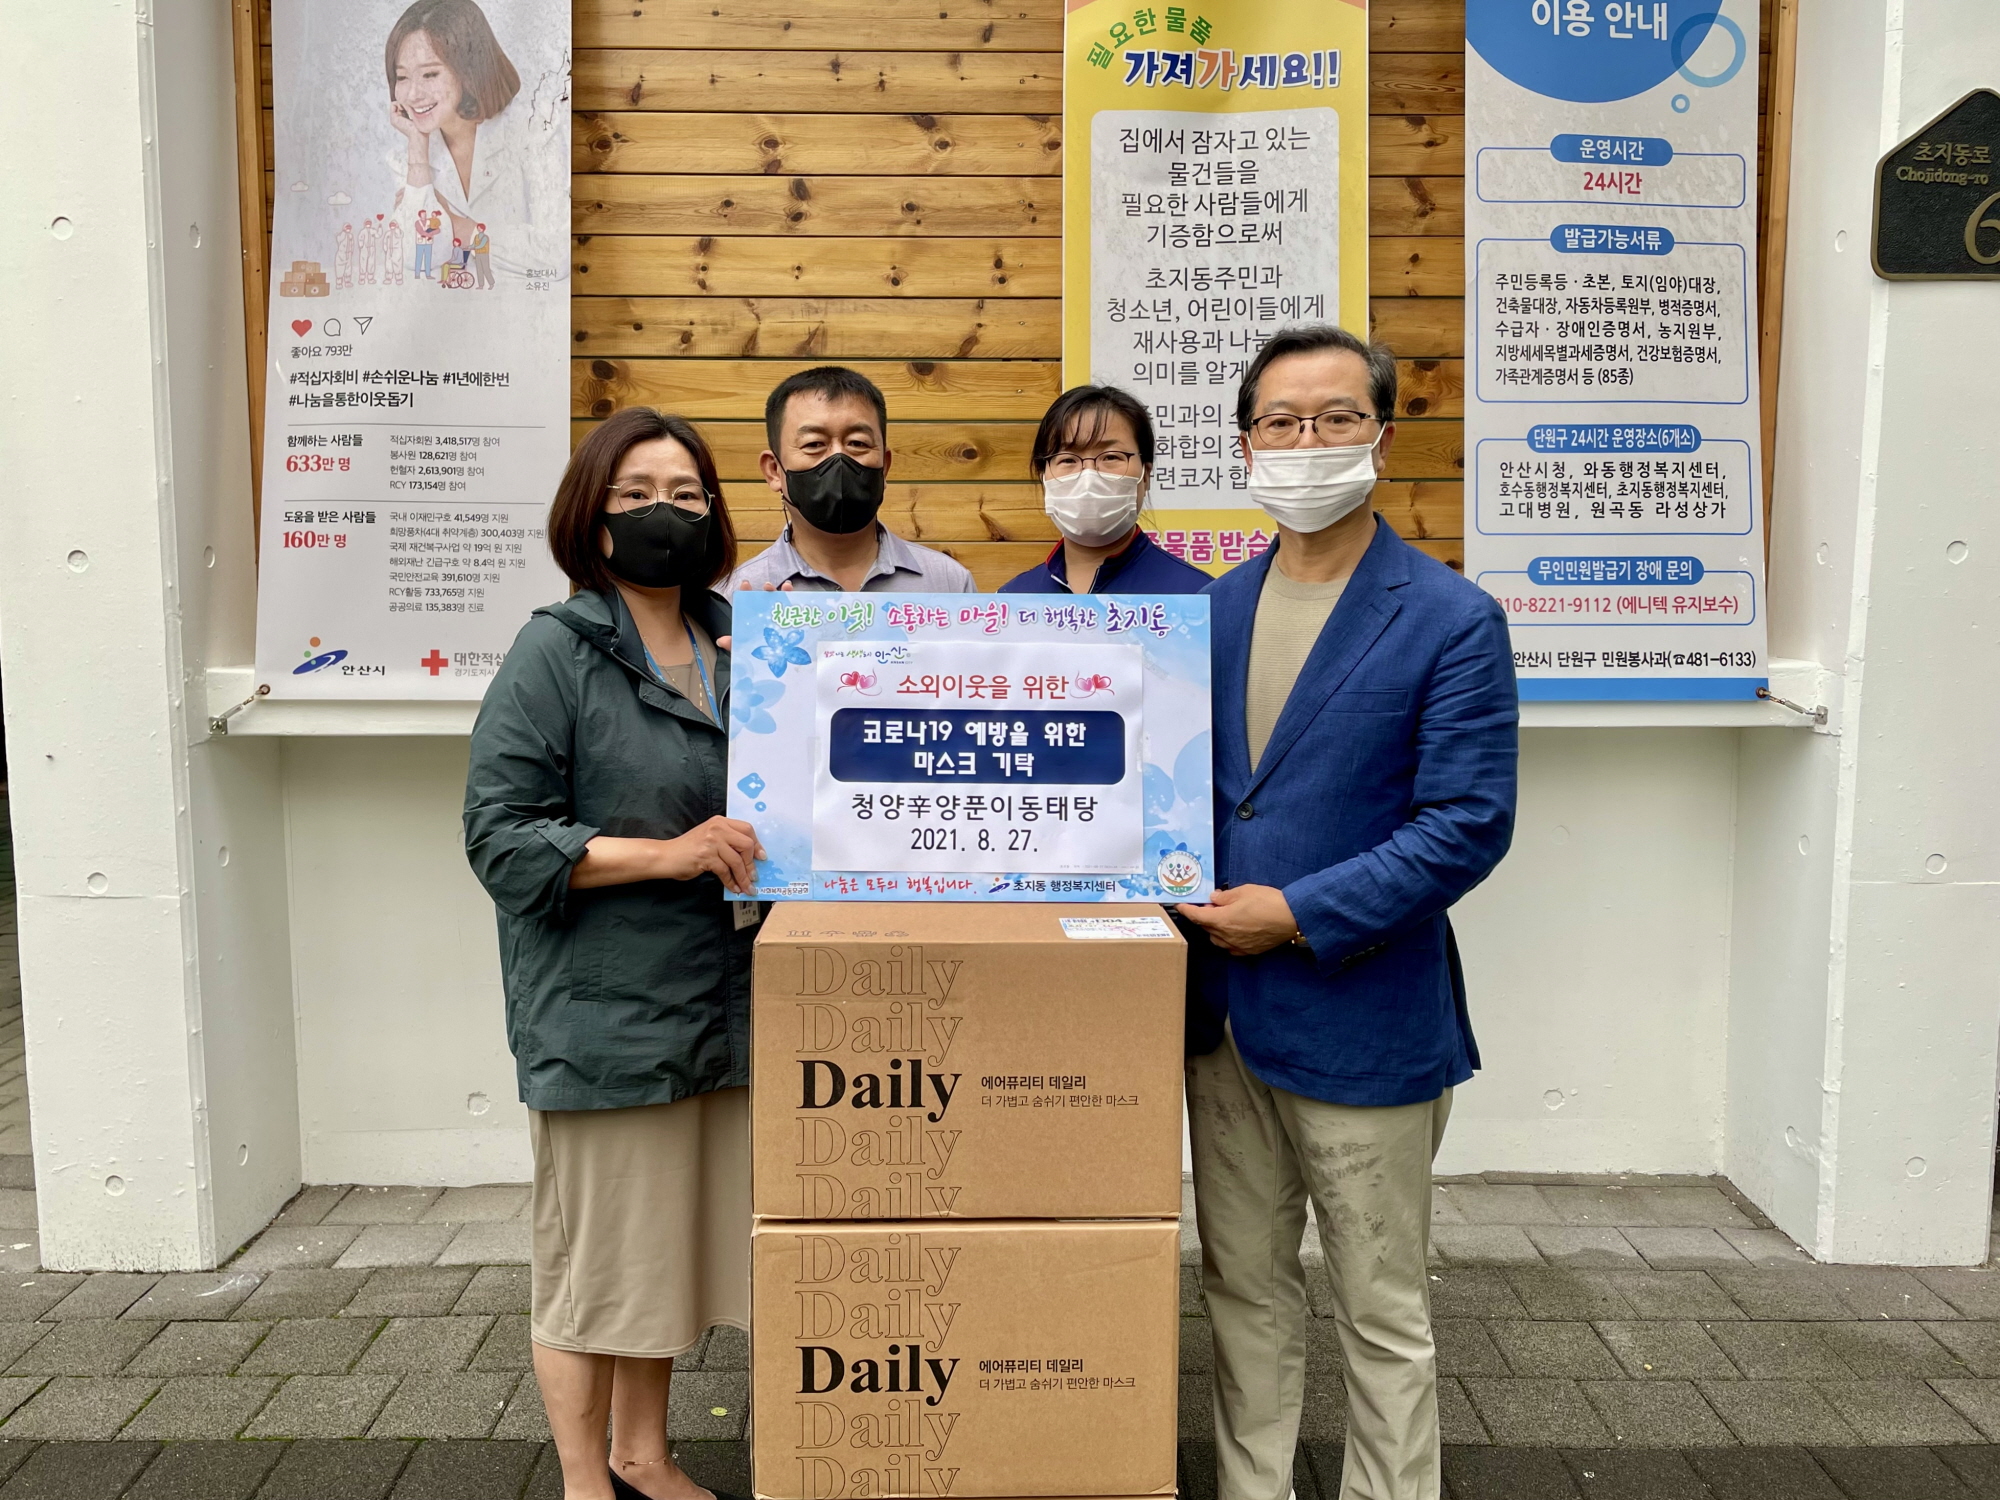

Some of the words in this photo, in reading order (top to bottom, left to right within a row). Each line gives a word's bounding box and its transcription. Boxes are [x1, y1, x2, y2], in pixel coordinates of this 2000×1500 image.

[1532, 0, 1594, 37] 이용
[1605, 1, 1667, 40] 안내
[1124, 49, 1340, 91] 가져가세요!!
[1119, 128, 1184, 154] 집에서
[1191, 129, 1259, 154] 잠자고
[1266, 127, 1310, 151] 있는
[1579, 139, 1644, 161] 운영시간
[1913, 142, 1991, 165] 초지동로
[1168, 160, 1259, 186] 물건들을
[1896, 167, 1989, 185] Chojidong-ro
[1583, 172, 1642, 195] 24시간
[1122, 192, 1188, 217] 필요한
[1194, 188, 1307, 216] 사람들에게
[1147, 221, 1282, 248] 기증함으로써
[1565, 228, 1661, 250] 발급가능서류
[526, 269, 557, 278] 홍보대사
[1146, 265, 1282, 291] 초지동주민과
[526, 281, 549, 291] 소유진
[1495, 274, 1568, 291] 주민등록등
[1582, 274, 1615, 292] 초본,
[1621, 275, 1721, 295] 토지(임야)대장,
[1107, 298, 1181, 323] 청소년,
[1188, 294, 1325, 320] 어린이들에게
[1496, 297, 1561, 315] 건축물대장,
[1565, 297, 1654, 316] 자동차등록원부,
[1659, 298, 1720, 318] 병적증명서,
[1495, 321, 1539, 338] 수급자
[1556, 321, 1651, 340] 장애인증명서,
[1658, 323, 1721, 341] 농지원부,
[1133, 329, 1223, 353] 재사용과
[291, 346, 322, 358] 좋아요
[325, 345, 352, 357] 793만
[1495, 345, 1633, 363] 지방세세목별과세증명서,
[1637, 345, 1721, 364] 건강보험증명서,
[290, 370, 358, 386] #적십자회비
[363, 370, 439, 385] #손쉬운나눔
[443, 371, 509, 387] #1년에한번
[1133, 361, 1200, 385] 의미를
[1495, 368, 1578, 385] 가족관계증명서
[1582, 368, 1594, 385] 등
[1598, 368, 1633, 385] (85종)
[289, 393, 413, 407] #나눔을통한이웃돕기
[287, 435, 327, 447] 함께하는
[331, 434, 363, 447] 사람들
[390, 434, 432, 446] 적십자회원
[435, 437, 480, 447] 3,418,517명
[483, 436, 500, 447] 참여
[1534, 429, 1567, 448] 단원구
[1572, 429, 1609, 448] 24시간
[1612, 429, 1695, 449] 운영장소(6개소)
[286, 455, 334, 472] 633만
[338, 456, 350, 472] 명
[390, 450, 416, 460] 봉사원
[419, 451, 457, 461] 128,621명
[460, 451, 477, 461] 참여
[390, 465, 415, 476] 헌혈자
[418, 466, 464, 476] 2,613,901명
[467, 466, 484, 477] 참여
[1500, 461, 1573, 479] 안산시청,
[1584, 461, 1726, 479] 와동행정복지센터,
[390, 480, 405, 490] RCY
[409, 481, 446, 491] 173,154명
[449, 481, 466, 491] 참여
[1499, 481, 1612, 499] 호수동행정복지센터,
[1617, 481, 1729, 499] 초지동행정복지센터,
[284, 511, 314, 523] 도움을
[318, 511, 338, 523] 받은
[342, 511, 376, 524] 사람들
[390, 512, 407, 522] 국내
[410, 512, 451, 522] 이재민구호
[454, 513, 489, 523] 41,549명
[492, 514, 509, 523] 지원
[1499, 502, 1579, 520] 고대병원,
[1591, 501, 1644, 519] 원곡동
[1655, 501, 1726, 519] 라성상가
[283, 530, 330, 548] 160만
[334, 533, 346, 548] 명
[389, 572, 439, 582] 국민안전교육
[442, 573, 480, 582] 391,610명
[483, 573, 500, 583] 지원
[1538, 561, 1632, 580] 무인민원발급기
[1636, 561, 1662, 580] 장애
[1666, 561, 1692, 580] 문의
[389, 587, 422, 596] RCY활동
[425, 588, 464, 597] 733,765명
[468, 588, 484, 597] 지원
[389, 603, 422, 611] 공공의료
[426, 603, 465, 612] 135,383명
[468, 604, 484, 612] 진료
[1617, 596, 1667, 614] (에니텍
[1672, 596, 1738, 614] 유지보수)
[772, 604, 822, 626] 친근한
[828, 602, 874, 633] 이웃!
[887, 602, 950, 633] 소통하는
[960, 602, 1007, 634] 마을!
[1018, 610, 1037, 624] 더
[1045, 606, 1097, 630] 행복한
[1105, 602, 1171, 637] 초지동
[1514, 652, 1552, 668] 안산시
[1558, 652, 1597, 668] 단원구
[342, 665, 385, 676] 안산시
[897, 675, 1011, 699] 소외이웃을
[1023, 675, 1069, 699] 위한
[863, 721, 952, 745] 코로나19
[965, 722, 1029, 747] 예방을
[1044, 722, 1086, 747] 위한
[914, 752, 976, 775] 마스크
[992, 753, 1034, 777] 기탁
[852, 794, 1098, 822] 청양辛양푼이동태탕
[911, 828, 965, 851] 2021.
[978, 829, 995, 852] 8.
[1008, 829, 1037, 852] 27.
[824, 878, 858, 894] 나눔은
[866, 879, 898, 892] 모두의
[907, 876, 976, 894] 행복입니다.
[1013, 880, 1046, 892] 초지동
[1050, 880, 1116, 892] 행정복지센터
[796, 945, 963, 1009] Daily
[796, 1001, 963, 1067] Daily
[796, 1059, 962, 1122] Daily
[981, 1075, 1044, 1090] 에어퓨리티
[1050, 1075, 1086, 1090] 데일리
[981, 1095, 992, 1107] 더
[995, 1094, 1029, 1108] 가볍고
[1032, 1095, 1065, 1108] 숨쉬기
[1069, 1095, 1102, 1108] 편안한
[1105, 1094, 1139, 1107] 마스크
[796, 1116, 962, 1180] Daily
[795, 1233, 961, 1296] Daily
[795, 1289, 961, 1352] Daily
[795, 1344, 960, 1406] Daily
[979, 1360, 1041, 1374] 에어퓨리티
[1047, 1359, 1083, 1373] 데일리
[979, 1379, 990, 1390] 더
[994, 1378, 1026, 1391] 가볍고
[1030, 1378, 1063, 1390] 숨쉬기
[1067, 1378, 1099, 1390] 편안한
[1103, 1377, 1136, 1389] 마스크
[795, 1399, 960, 1461] Daily
